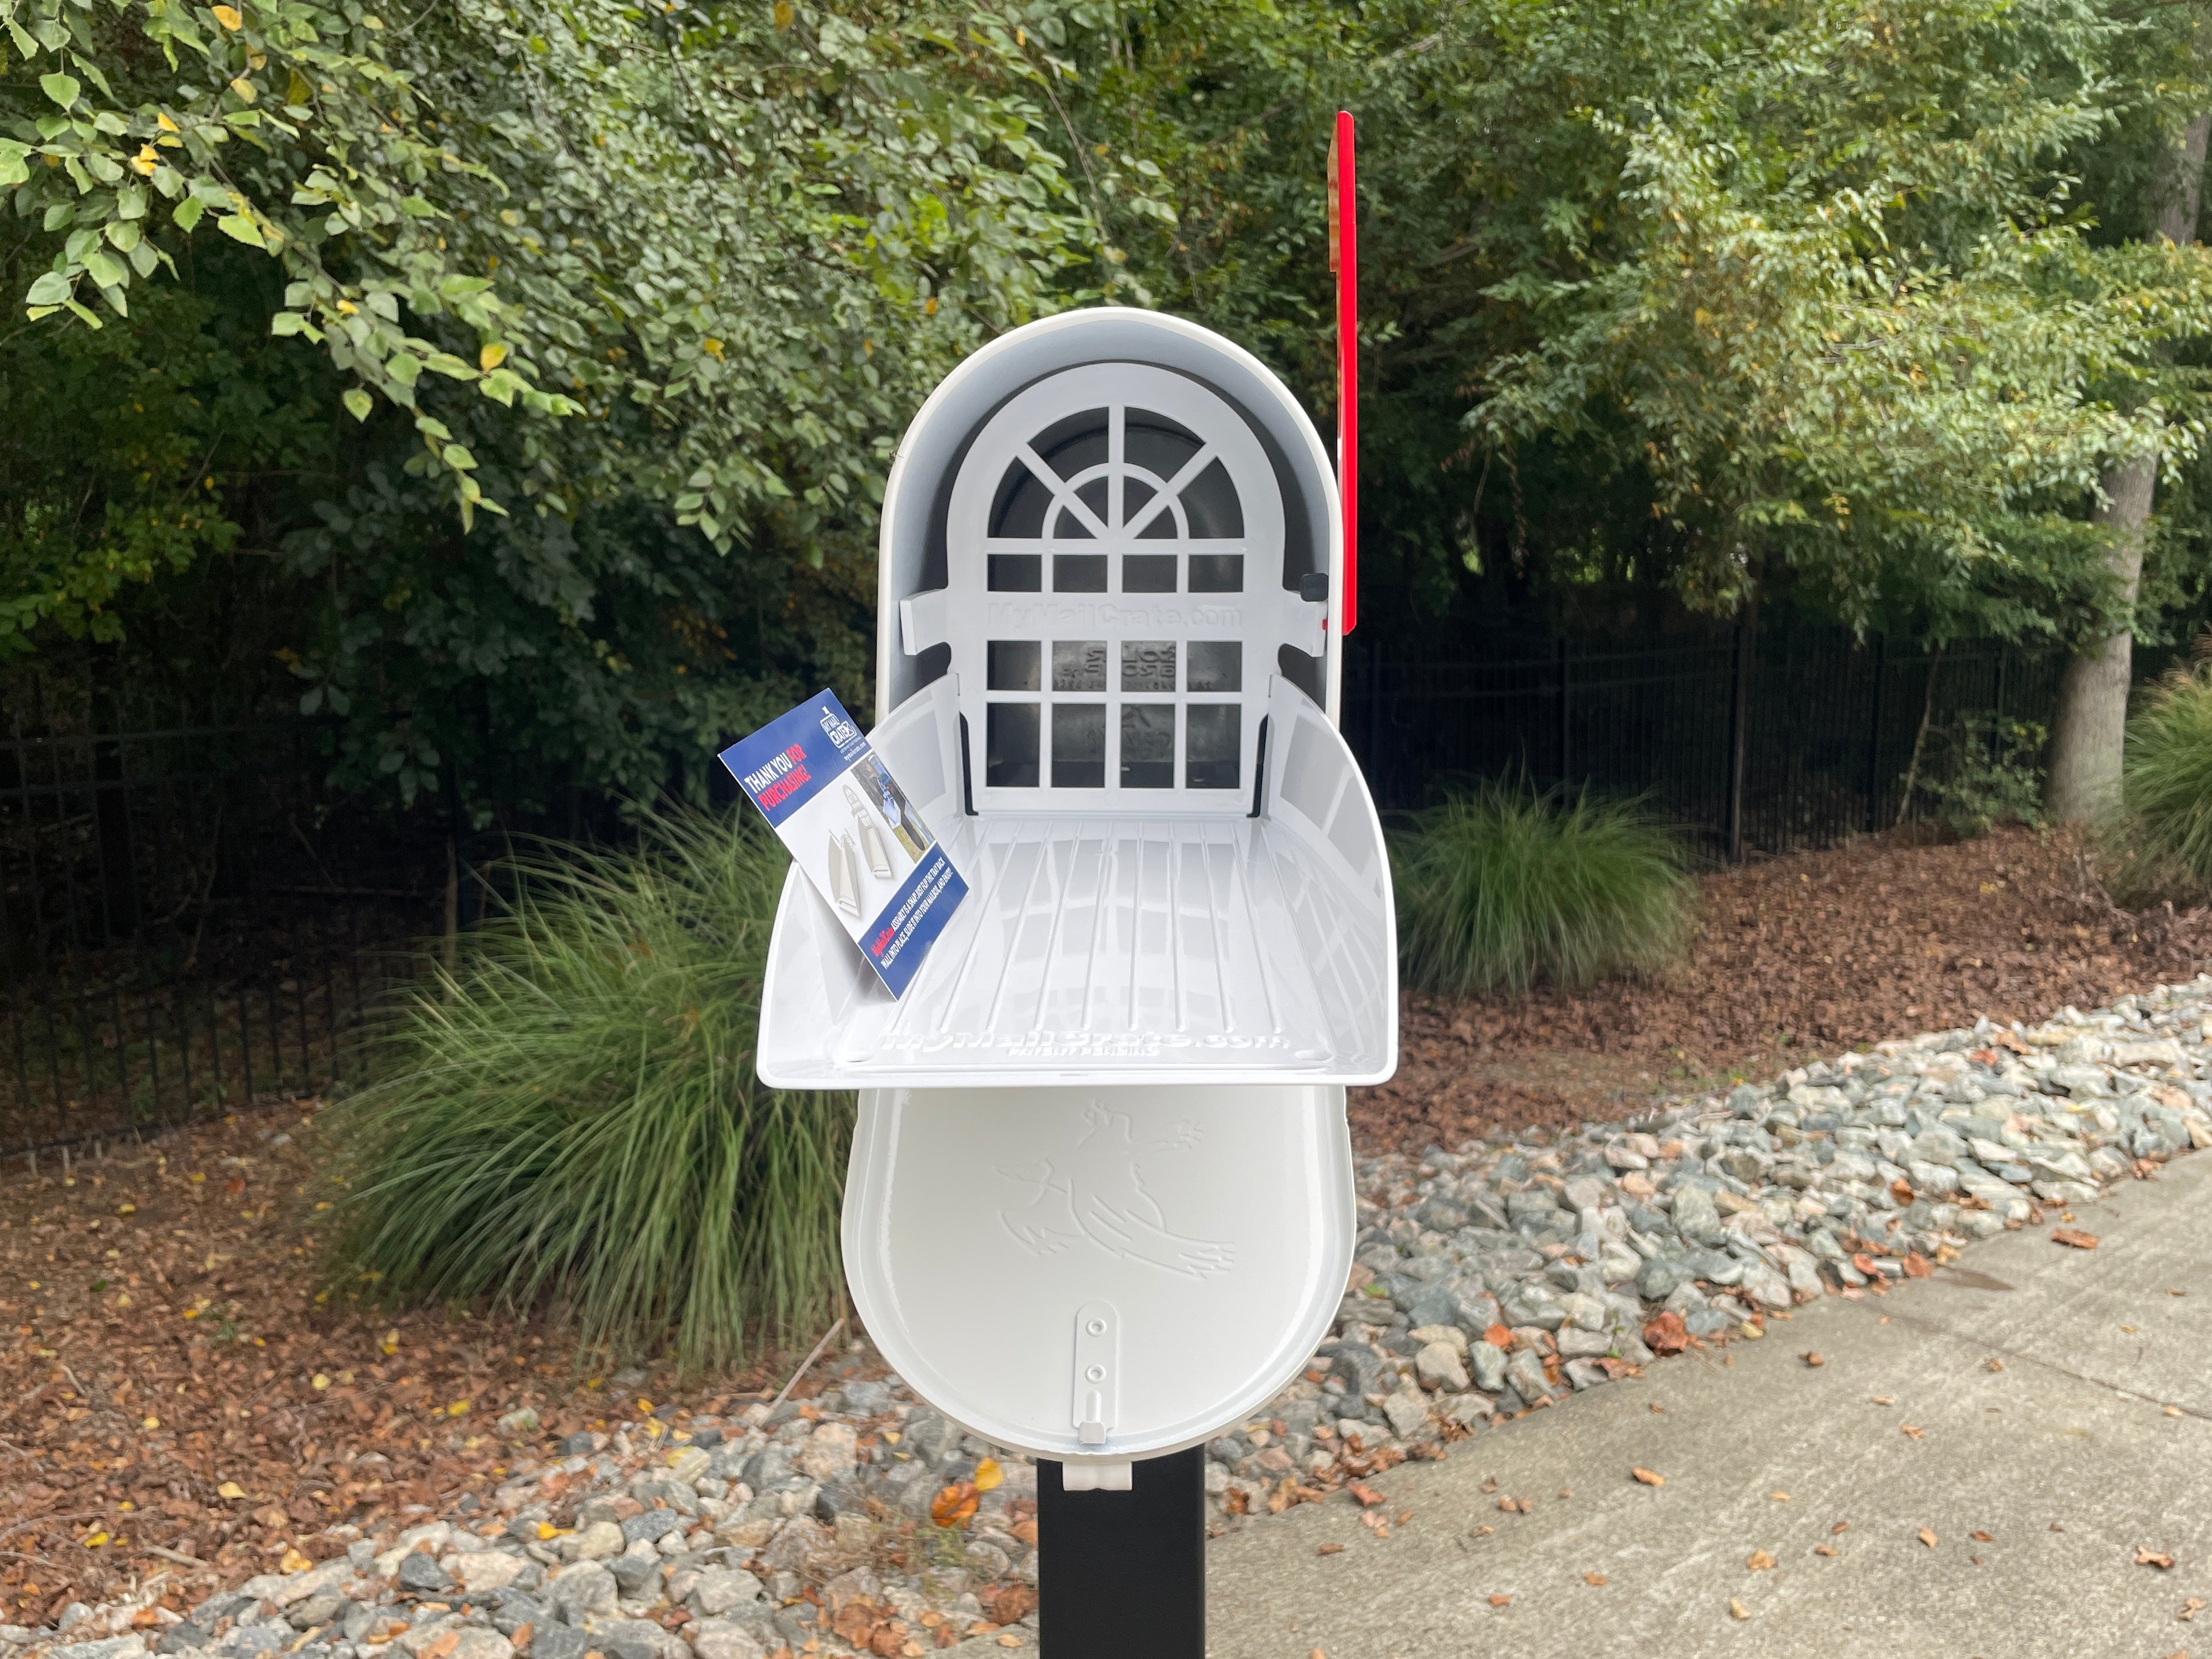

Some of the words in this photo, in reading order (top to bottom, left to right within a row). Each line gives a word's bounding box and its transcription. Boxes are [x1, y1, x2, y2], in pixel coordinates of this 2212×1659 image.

[988, 602, 1243, 629] MyMailCrate.com
[829, 725, 850, 745] CRATE
[744, 762, 779, 794] THANK
[769, 752, 793, 775] YOU
[786, 743, 808, 765] FOR
[757, 764, 812, 812] PURCHASING!
